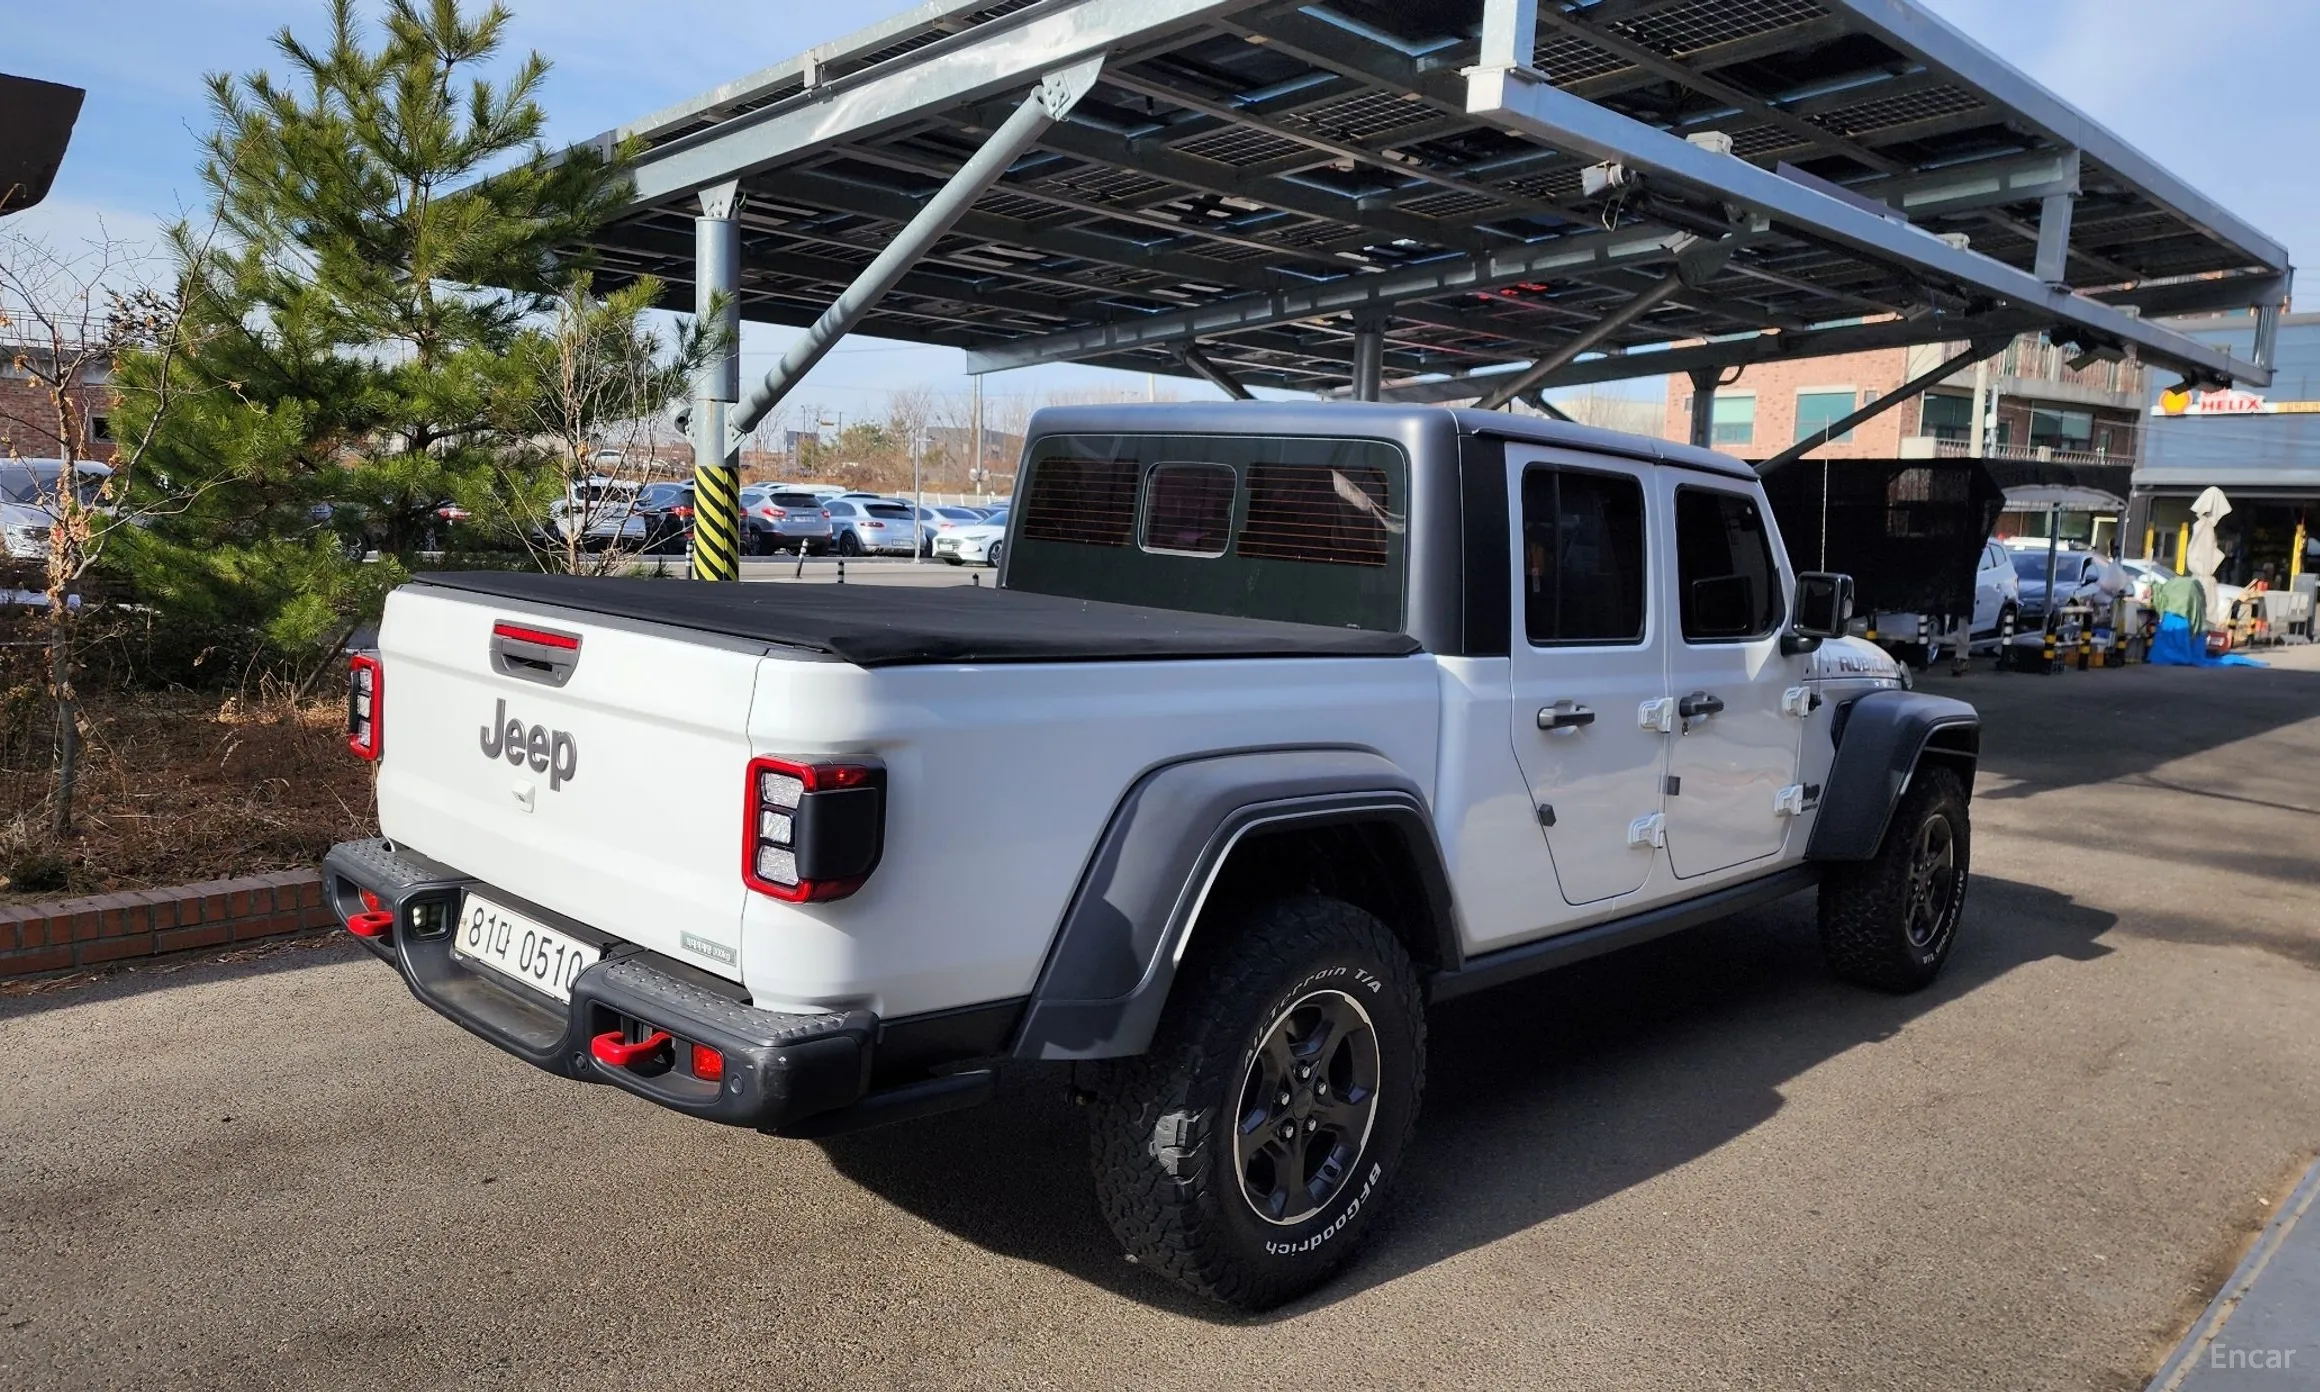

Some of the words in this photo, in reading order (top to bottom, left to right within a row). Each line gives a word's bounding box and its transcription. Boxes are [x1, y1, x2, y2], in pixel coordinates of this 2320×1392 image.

[2201, 398, 2260, 412] HELIX
[480, 697, 577, 792] Jeep
[468, 907, 512, 960] 81다
[519, 930, 583, 994] 0510
[1353, 968, 1382, 994] T/A
[1265, 1162, 1381, 1256] BFGoodrich
